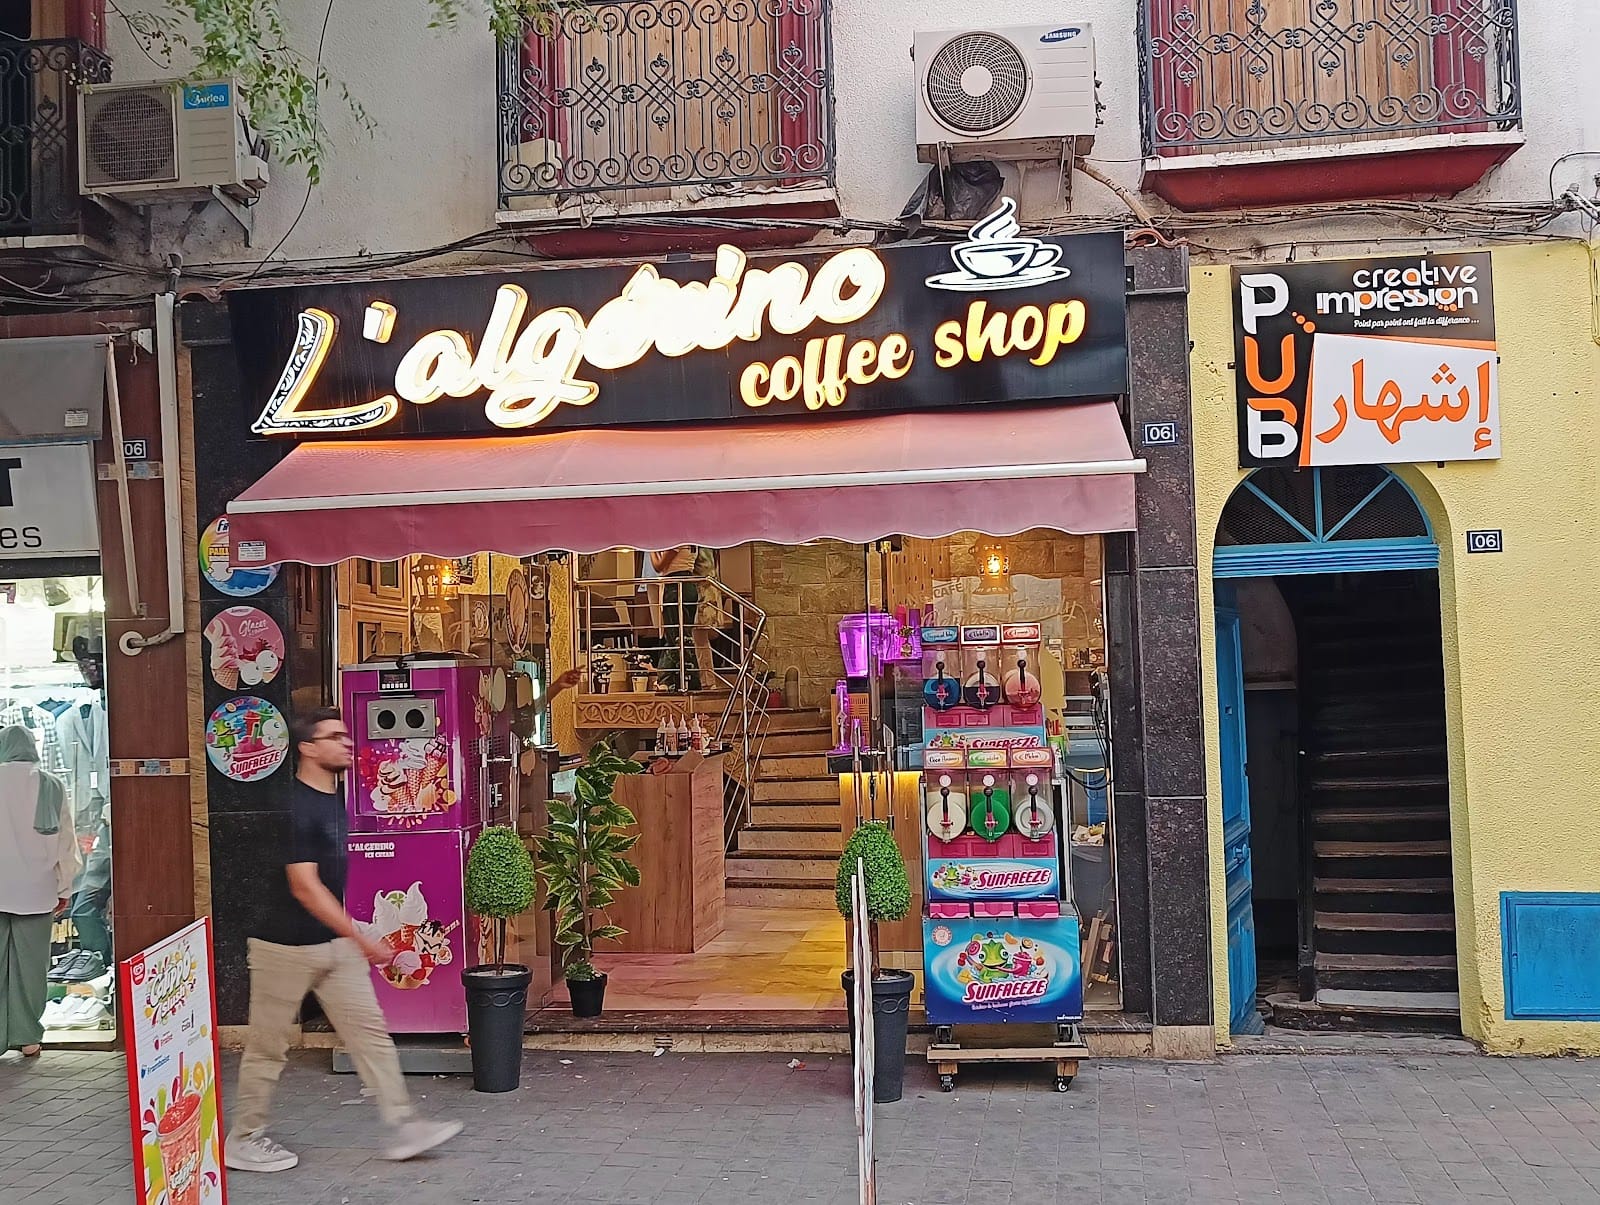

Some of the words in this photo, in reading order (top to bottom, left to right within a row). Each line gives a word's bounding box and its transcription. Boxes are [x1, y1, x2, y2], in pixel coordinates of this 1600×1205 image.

[1353, 260, 1478, 288] creative
[1316, 287, 1479, 316] impression
[739, 333, 914, 411] coffee
[933, 299, 1087, 368] shop
[1240, 273, 1299, 459] PUB
[1314, 358, 1493, 452] إشهار
[1149, 426, 1171, 440] 06
[124, 443, 143, 456] 06
[1475, 534, 1497, 548] 06
[229, 751, 281, 775] SUNFREEZE
[977, 869, 1050, 888] SUNFREEZE
[963, 979, 1046, 1001] SUNFREEZE
